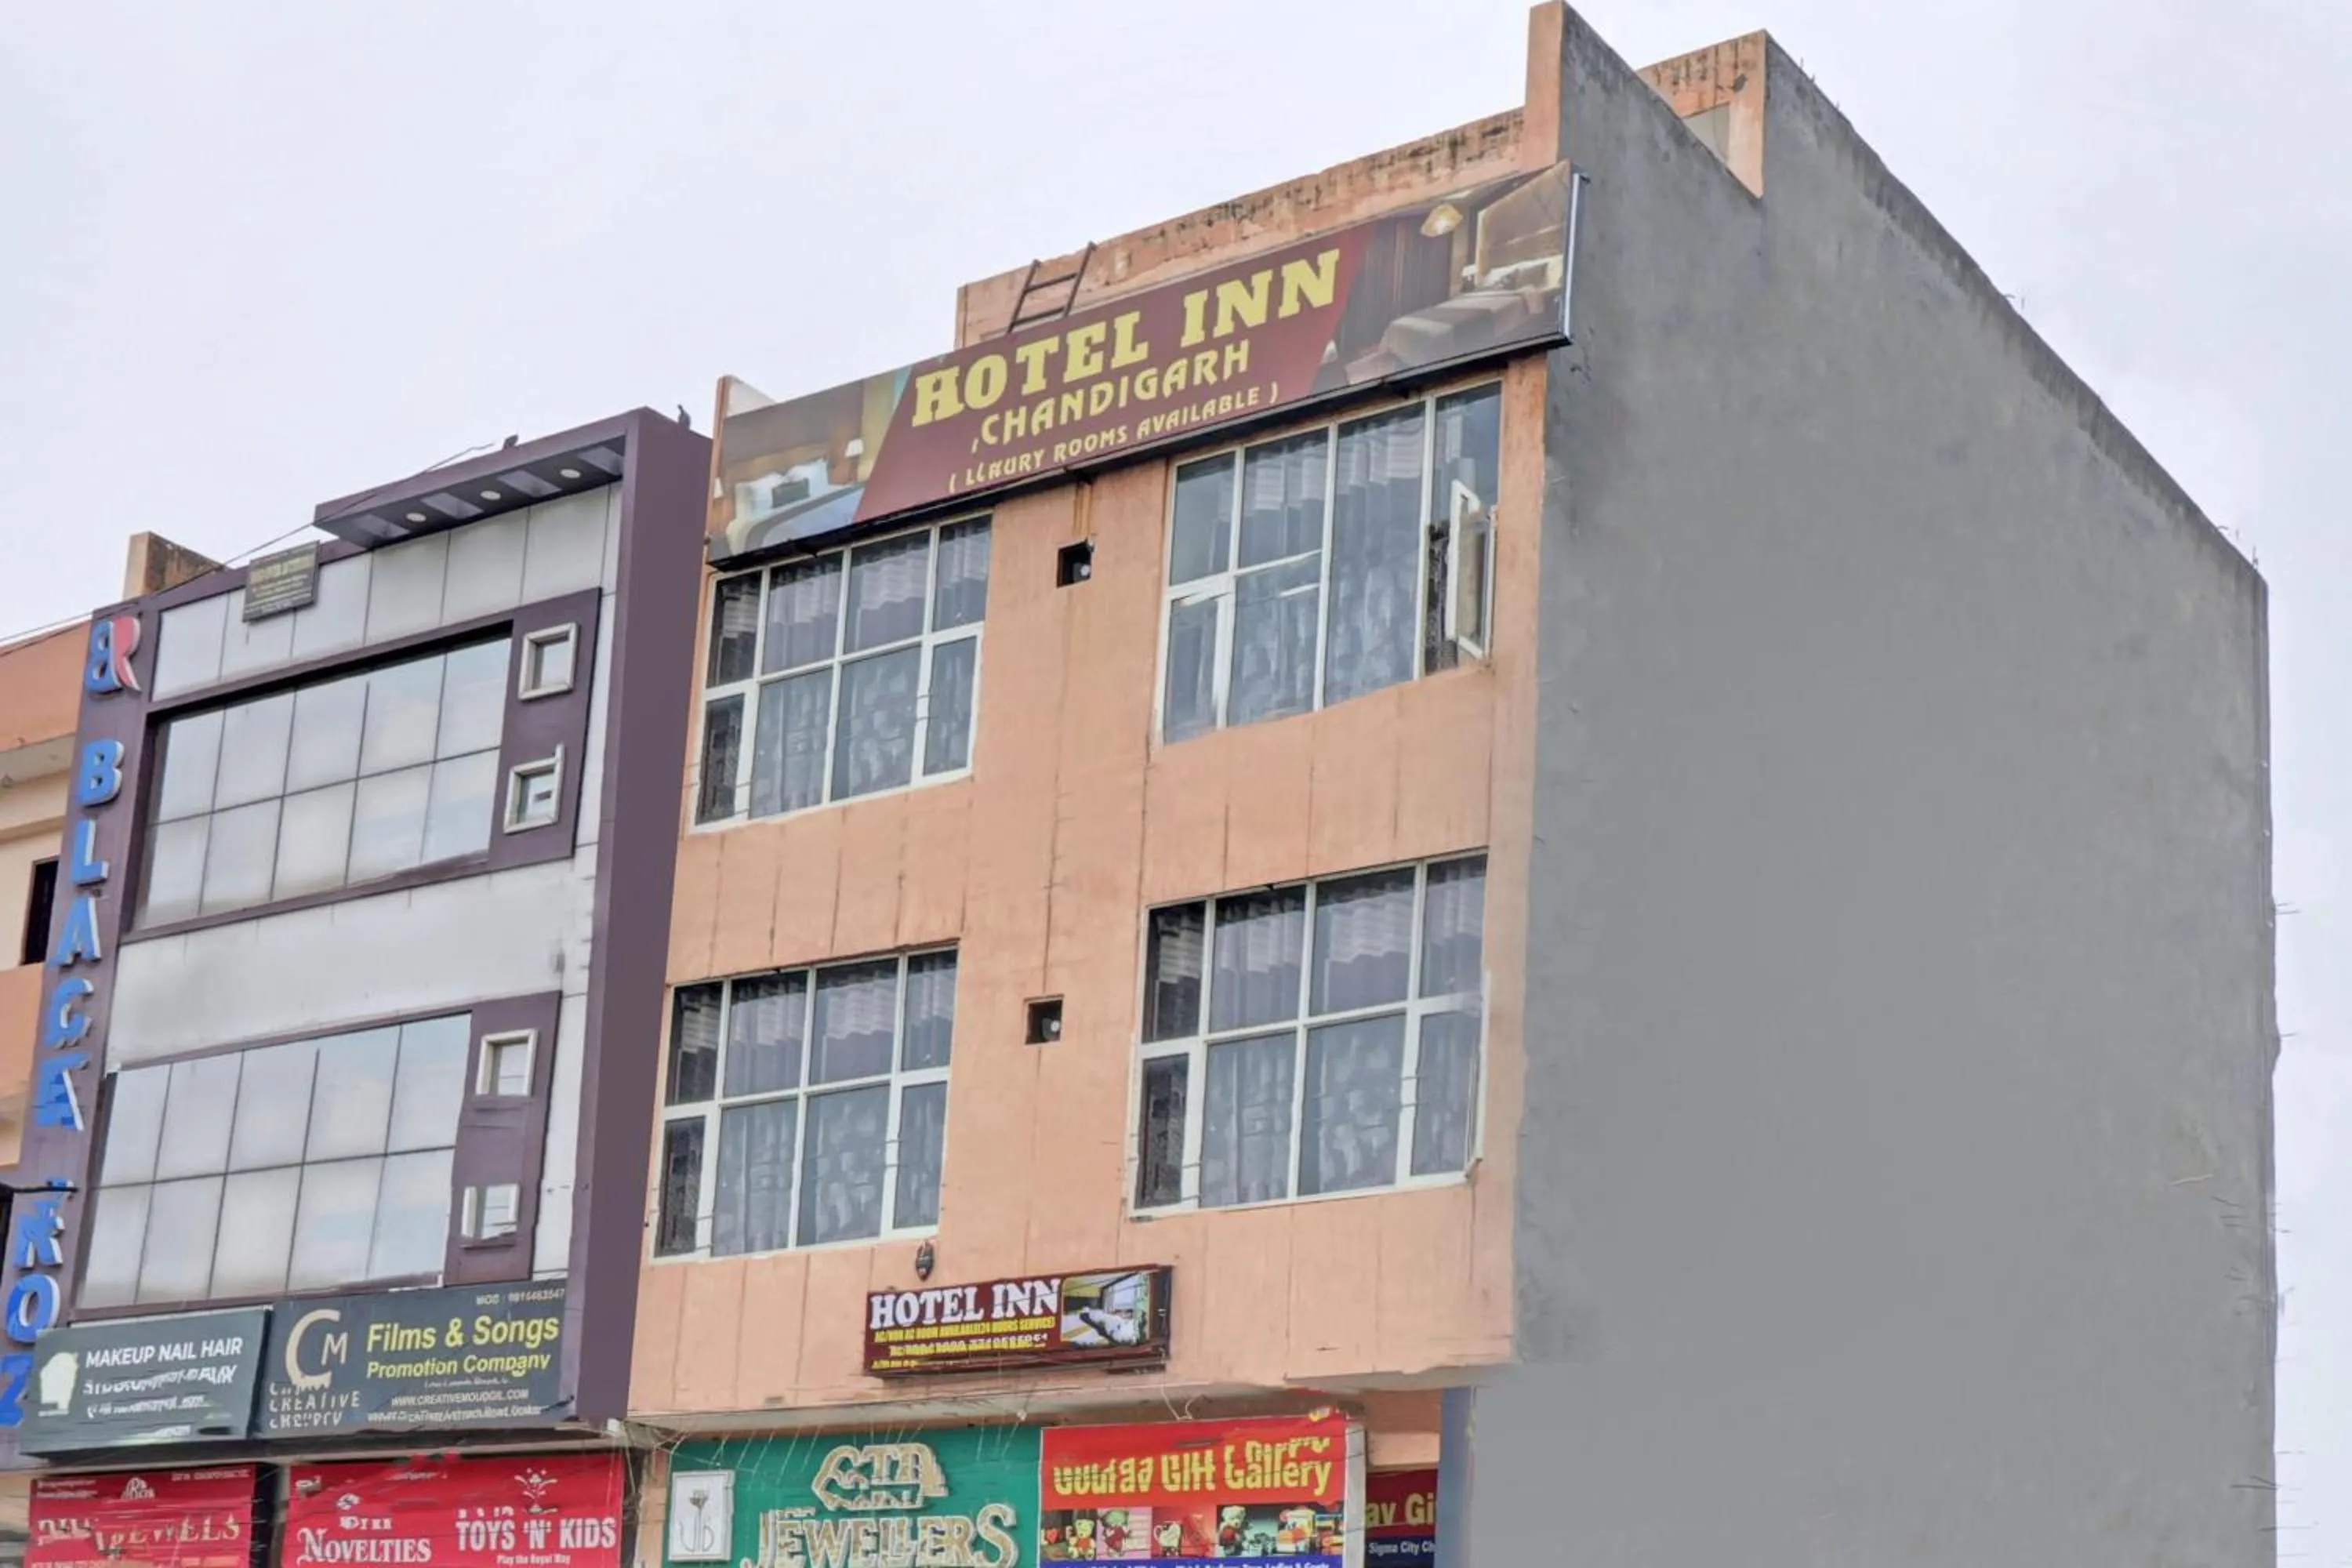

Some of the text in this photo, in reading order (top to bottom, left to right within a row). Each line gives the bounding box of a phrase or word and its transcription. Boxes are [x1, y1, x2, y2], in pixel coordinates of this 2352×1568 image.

[912, 249, 1340, 427] HOTEL INN
[981, 339, 1250, 447] CHANDIGARH
[1054, 425, 1127, 463] ROOMS
[1137, 387, 1260, 440] AVAILABLE
[869, 1278, 1062, 1329] HOTEL INN
[85, 1337, 243, 1368] MAKEUP NAIL HAIR
[366, 1314, 560, 1352] Films & Songs
[366, 1353, 551, 1379] Promotion Company
[297, 1526, 432, 1566] NOVELTIES
[456, 1519, 516, 1552] TOYS
[559, 1516, 616, 1549] KIDS
